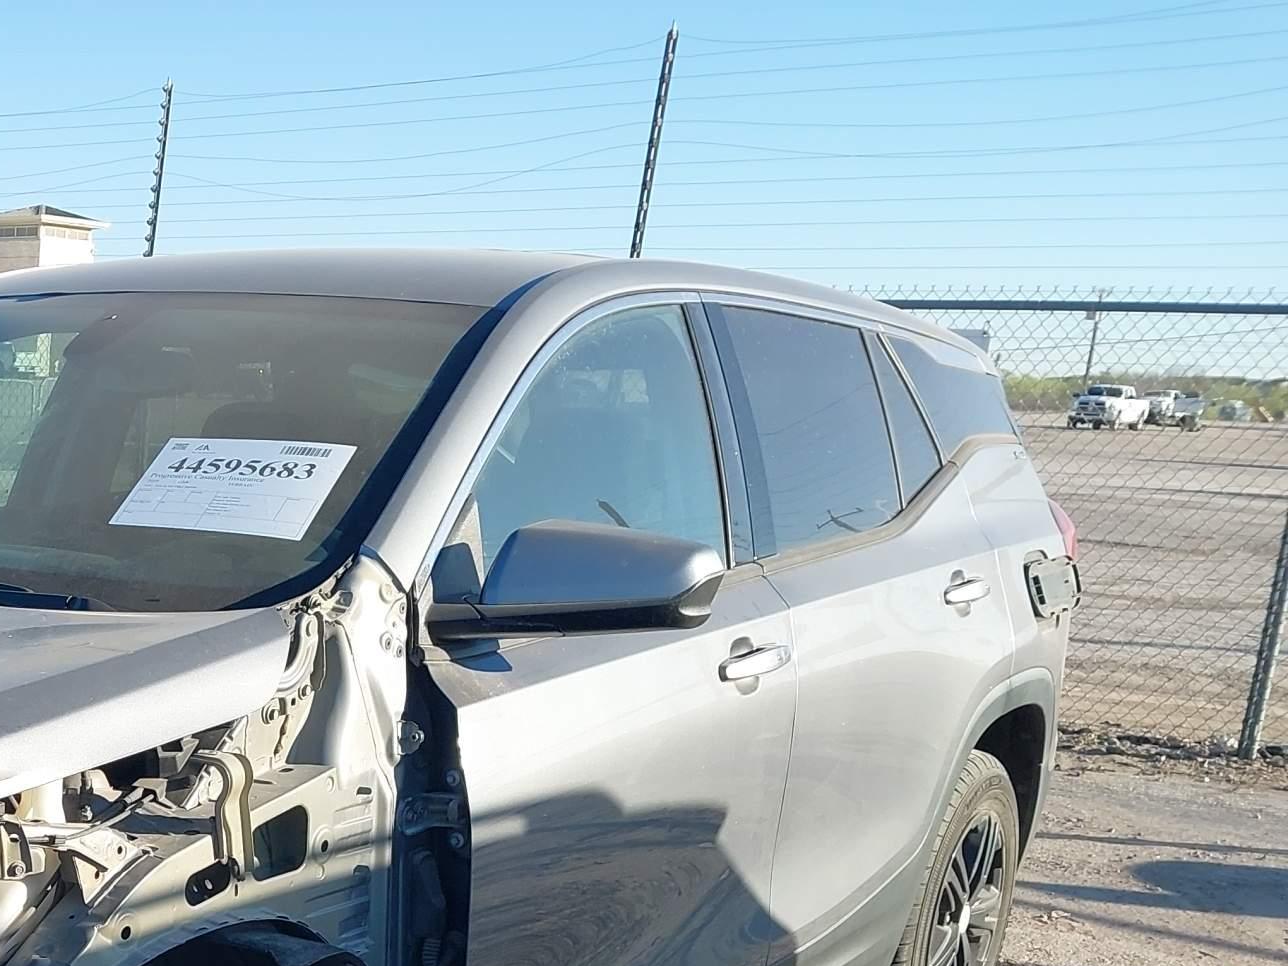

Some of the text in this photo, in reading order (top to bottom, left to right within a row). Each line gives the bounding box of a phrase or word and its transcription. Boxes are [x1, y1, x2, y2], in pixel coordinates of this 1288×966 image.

[167, 456, 317, 480] 44595683
[194, 474, 226, 482] Casualty
[228, 475, 266, 483] Insurance
